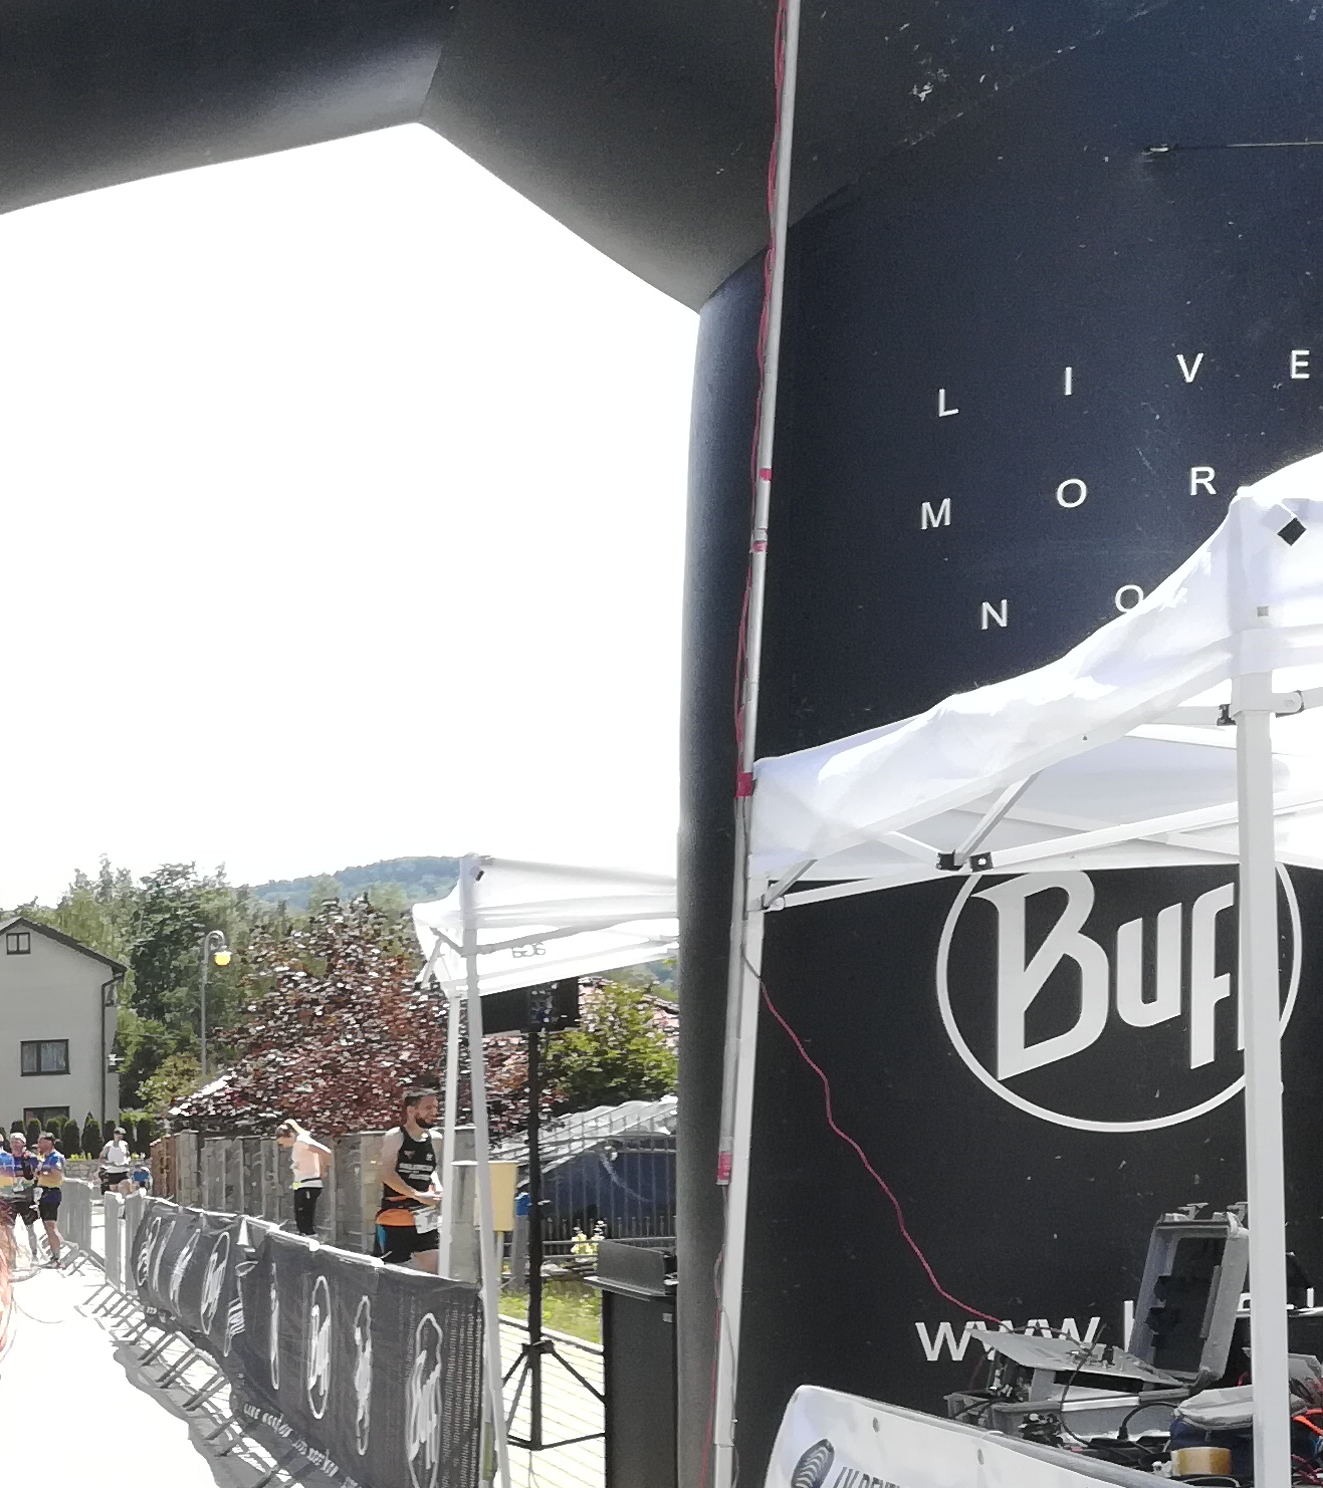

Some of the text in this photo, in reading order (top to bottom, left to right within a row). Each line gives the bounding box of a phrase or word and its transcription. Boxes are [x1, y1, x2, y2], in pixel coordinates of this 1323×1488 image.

[938, 350, 1310, 417] LIVE
[920, 466, 1216, 529] MOR
[980, 584, 1144, 630] NO
